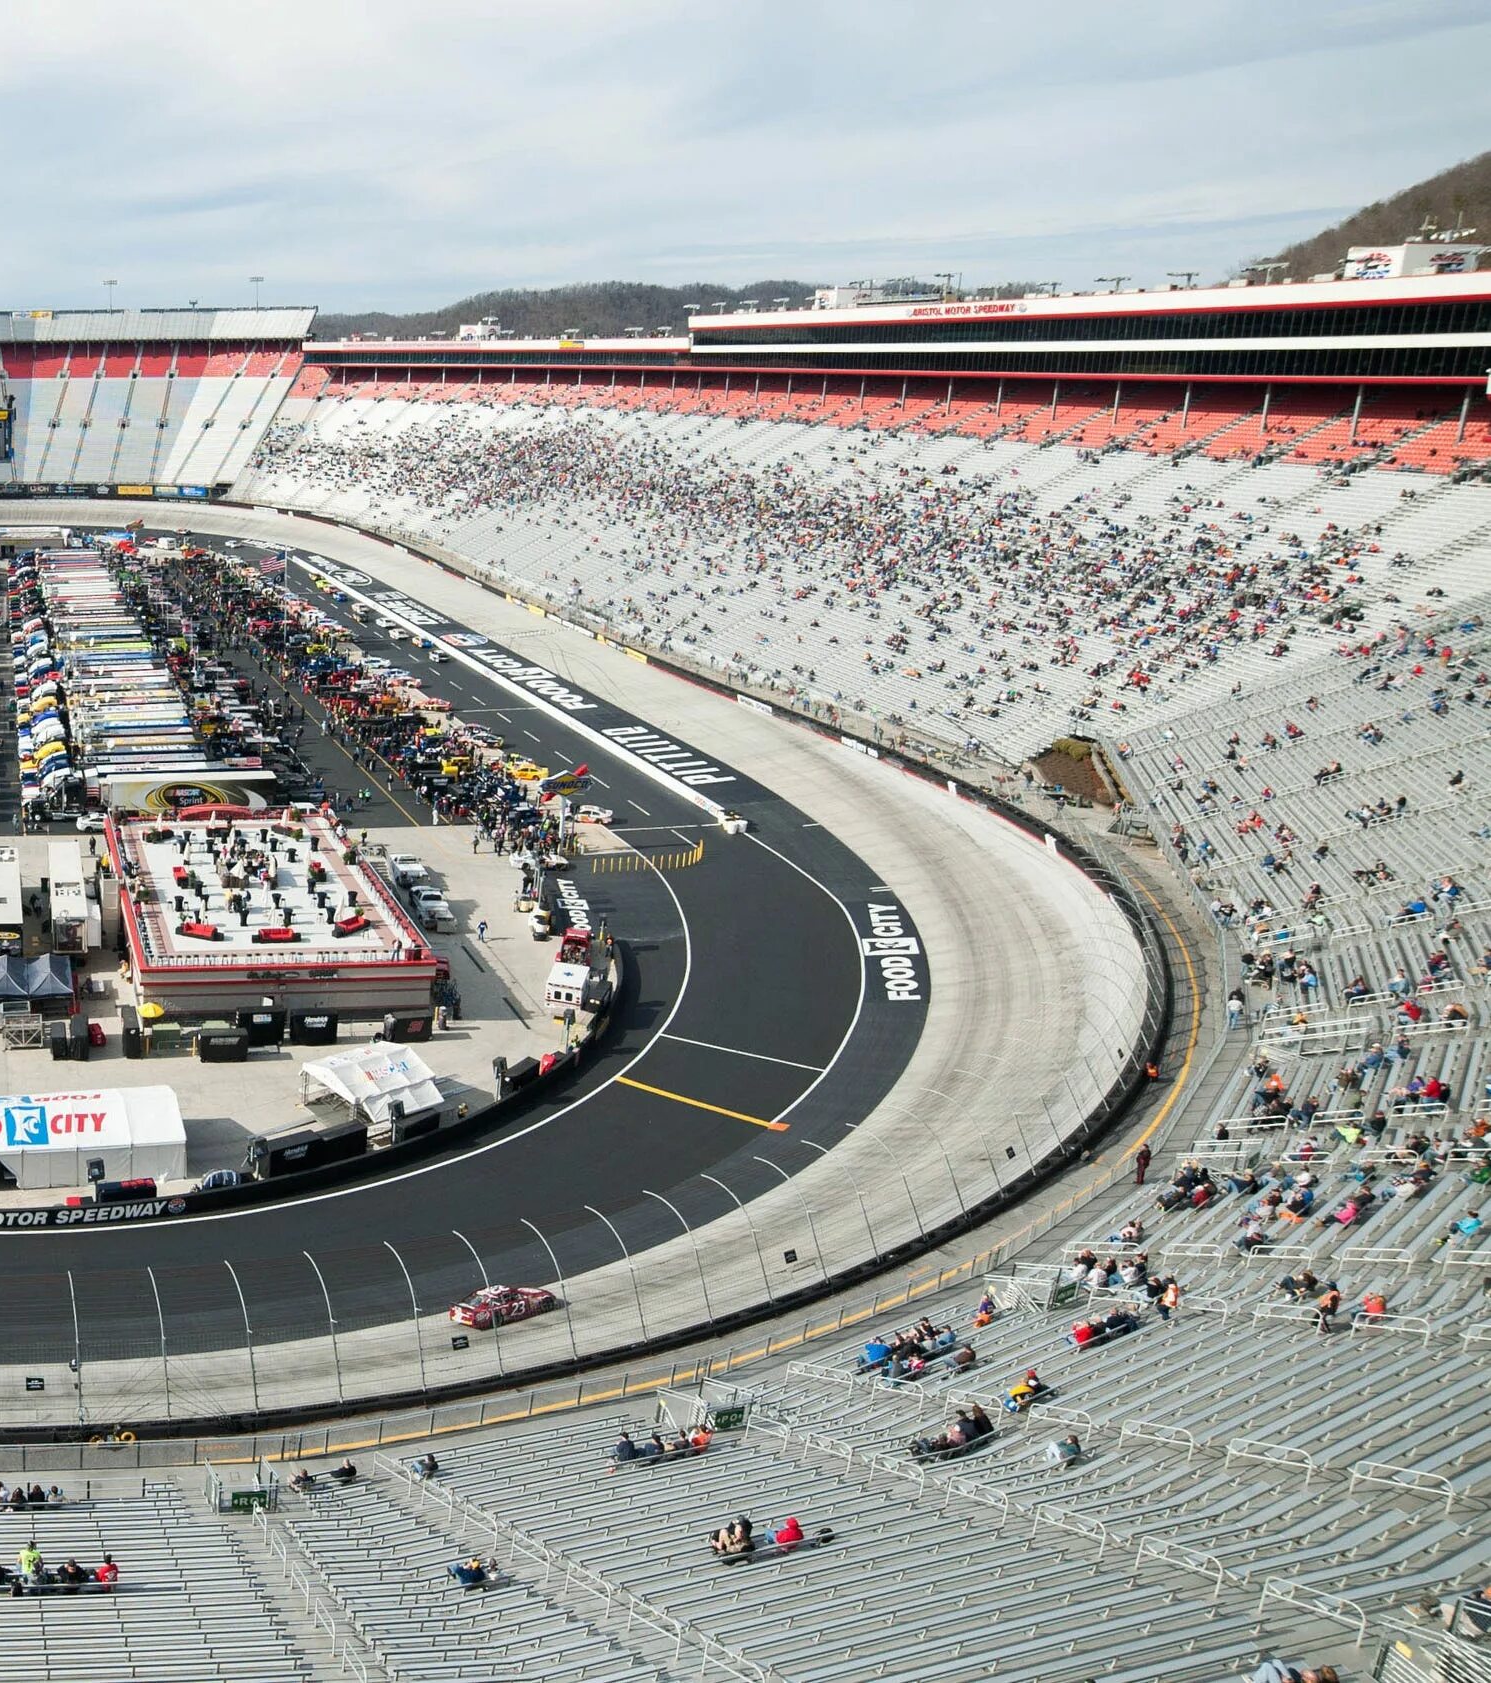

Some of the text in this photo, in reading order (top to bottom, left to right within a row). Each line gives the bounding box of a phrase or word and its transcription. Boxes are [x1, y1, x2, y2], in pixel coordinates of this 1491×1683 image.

[912, 303, 1015, 316] BRISTOL MOTOR SPEEDWAY
[468, 649, 597, 710] FOOD CITY
[175, 789, 201, 797] NASCAR
[542, 779, 592, 792] SUNOCO
[179, 796, 203, 805] Sprint
[556, 879, 592, 931] OOD CITY
[867, 903, 921, 1000] FOOD CITY
[50, 1113, 108, 1134] CITY
[54, 1200, 169, 1225] SPEEDWAY
[510, 1300, 526, 1316] 23
